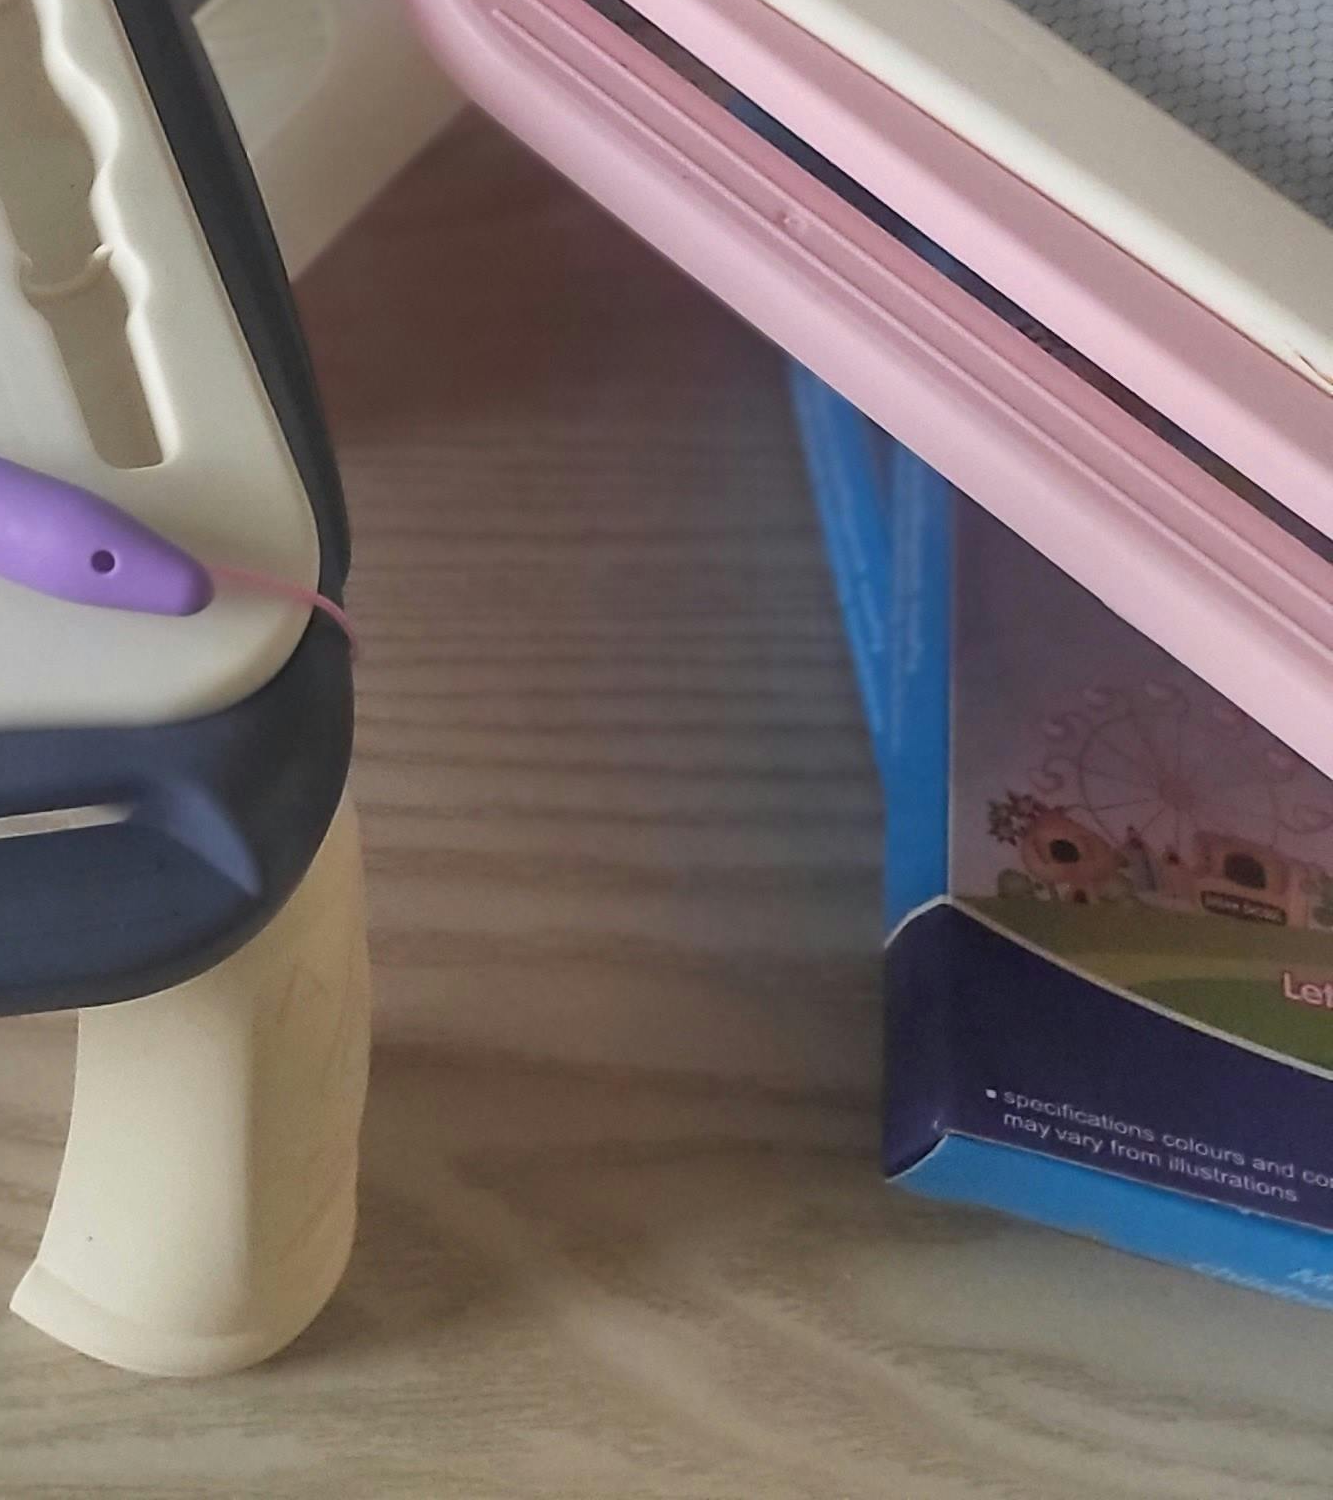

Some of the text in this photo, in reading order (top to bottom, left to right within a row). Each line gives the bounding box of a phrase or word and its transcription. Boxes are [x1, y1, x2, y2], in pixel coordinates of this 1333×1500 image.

[1002, 1090, 1333, 1190] specifications colours and co
[1003, 1111, 1299, 1202] may vary from illustrations
